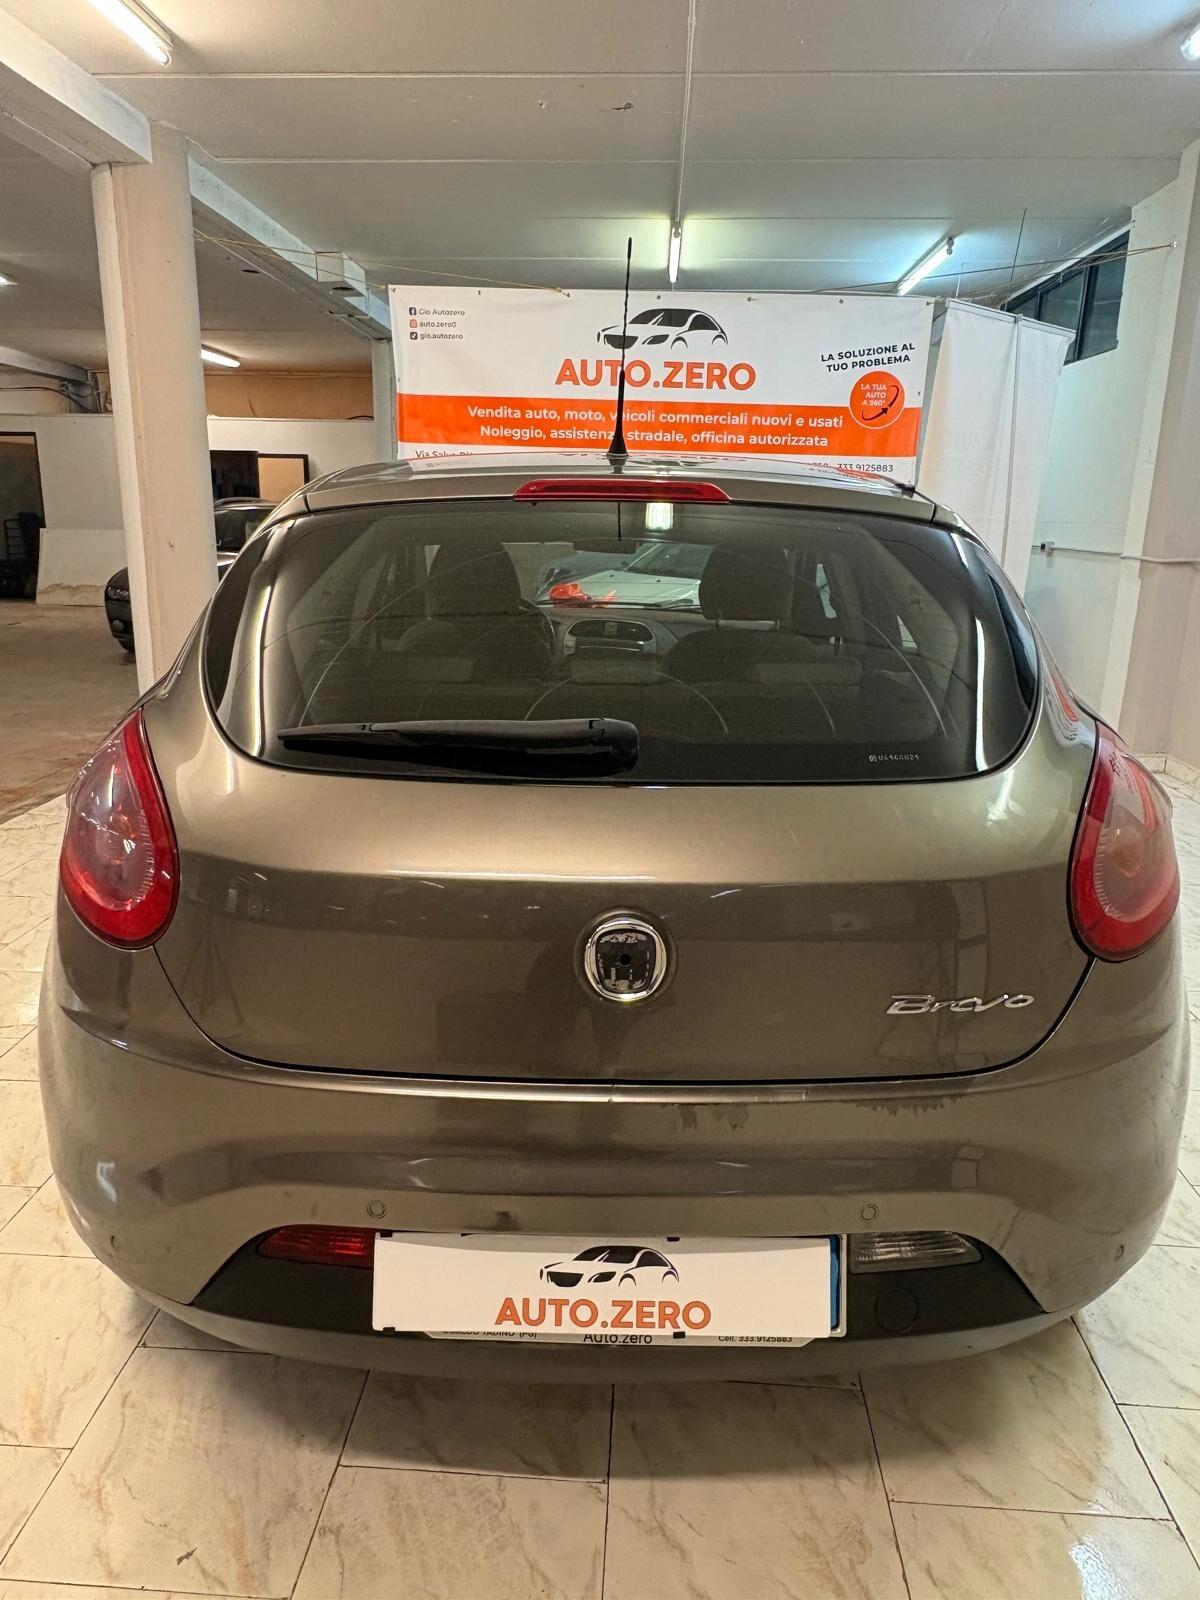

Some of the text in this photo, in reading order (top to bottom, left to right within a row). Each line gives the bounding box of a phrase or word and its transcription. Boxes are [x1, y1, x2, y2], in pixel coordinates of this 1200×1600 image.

[418, 308, 431, 316] Gio
[821, 342, 916, 362] LA SOLUZIONE AL
[826, 354, 911, 372] TUO PROBLEMA
[555, 358, 757, 391] AUTO.ZERO
[864, 391, 887, 399] AUTO
[872, 383, 888, 391] TUA
[862, 399, 869, 407] A
[467, 405, 844, 429] Vendita auto, moto, vicoli commerciali nuovi e usati
[480, 424, 829, 448] Noleggio, assistenz stradale, officina autorizzata
[415, 450, 430, 458] Via
[886, 994, 1034, 1015] Bravo
[494, 1297, 712, 1330] AUTO.ZERO
[583, 1333, 653, 1344] Auto.zero
